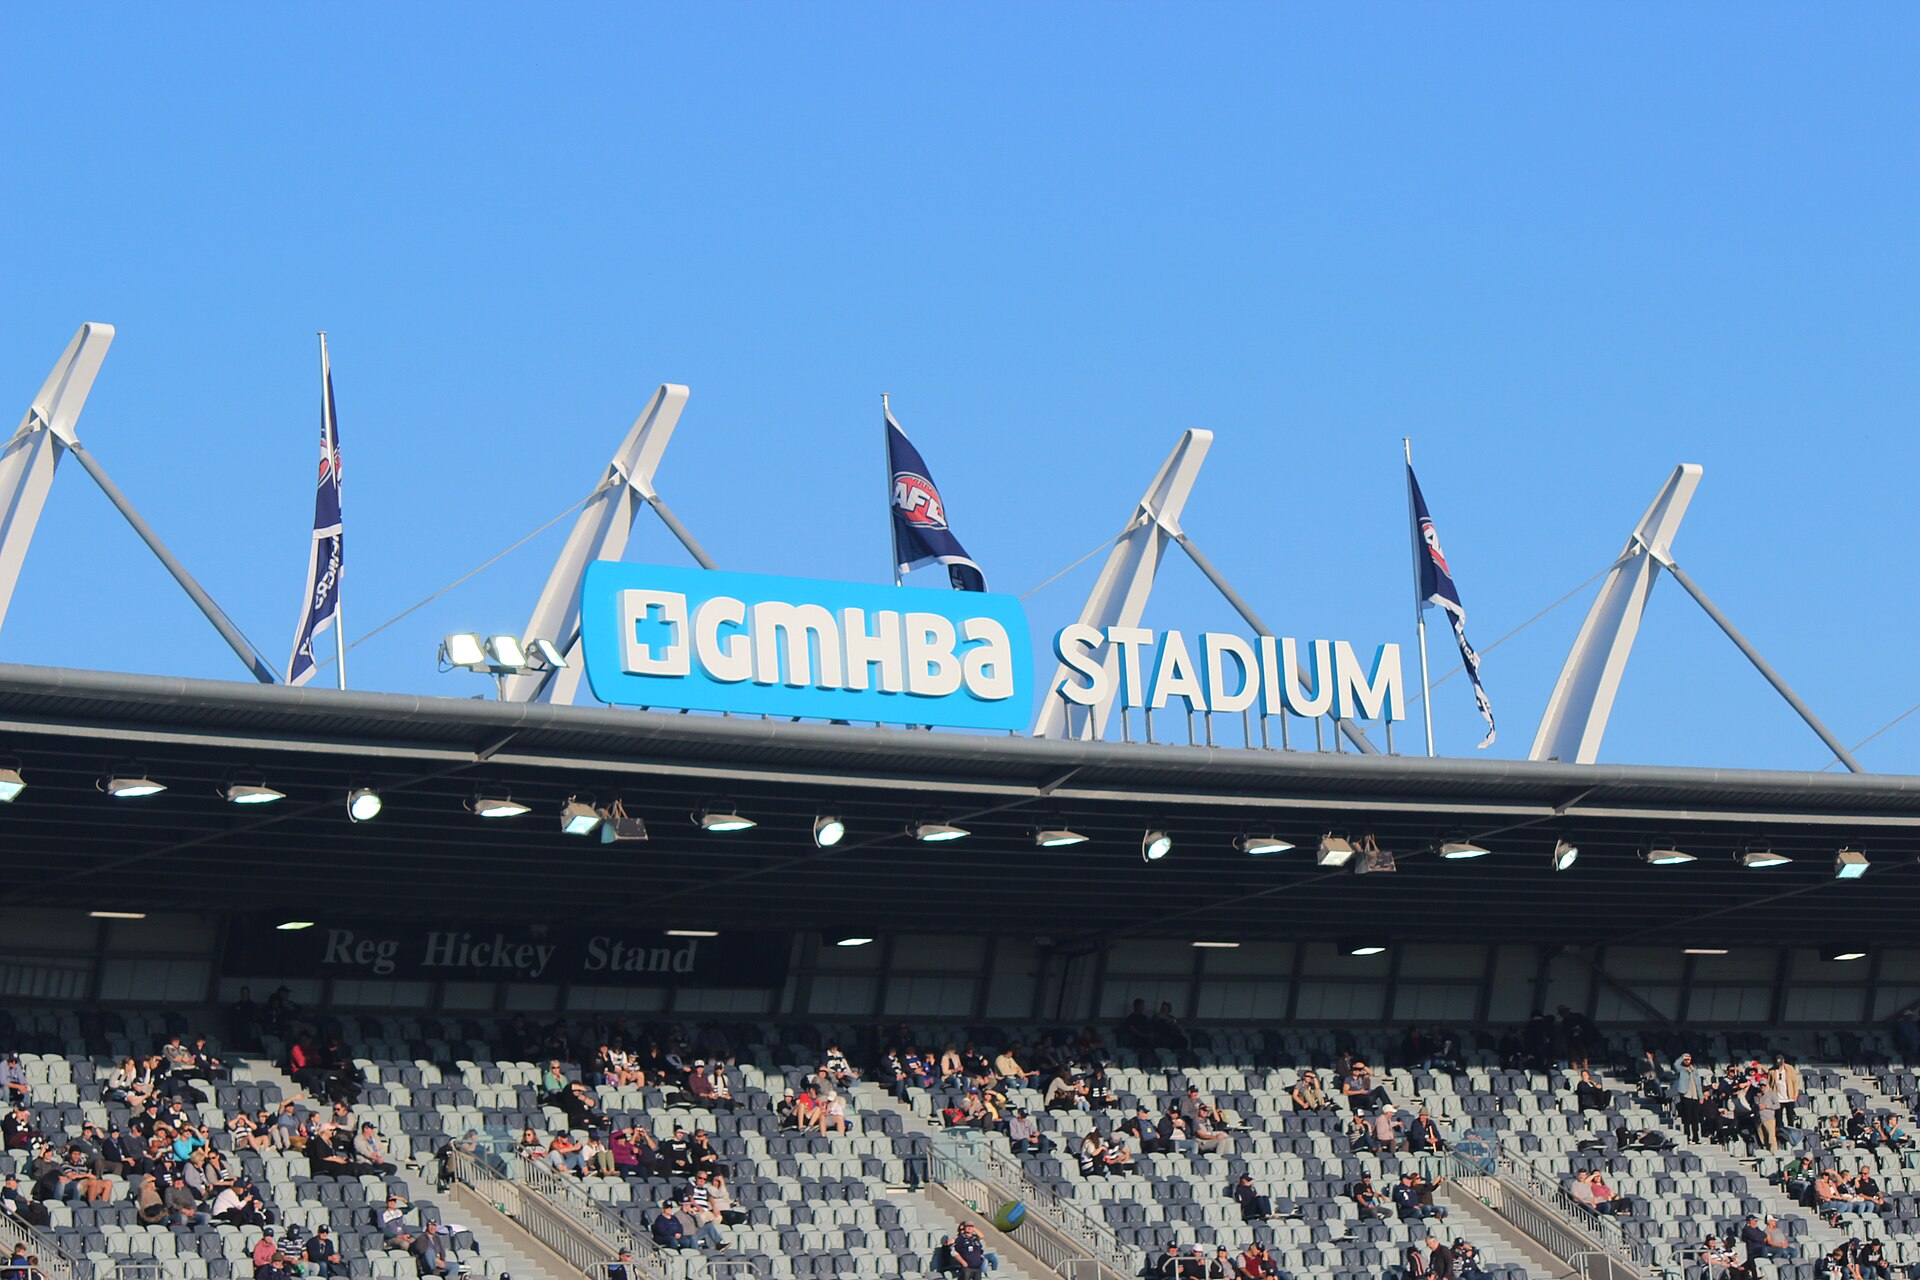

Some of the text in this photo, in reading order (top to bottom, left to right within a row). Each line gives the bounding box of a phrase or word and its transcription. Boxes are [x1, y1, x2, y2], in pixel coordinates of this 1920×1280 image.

[892, 481, 948, 528] AFL
[1054, 623, 1405, 721] STADIUM
[322, 928, 698, 977] Reg Hickey Stand
